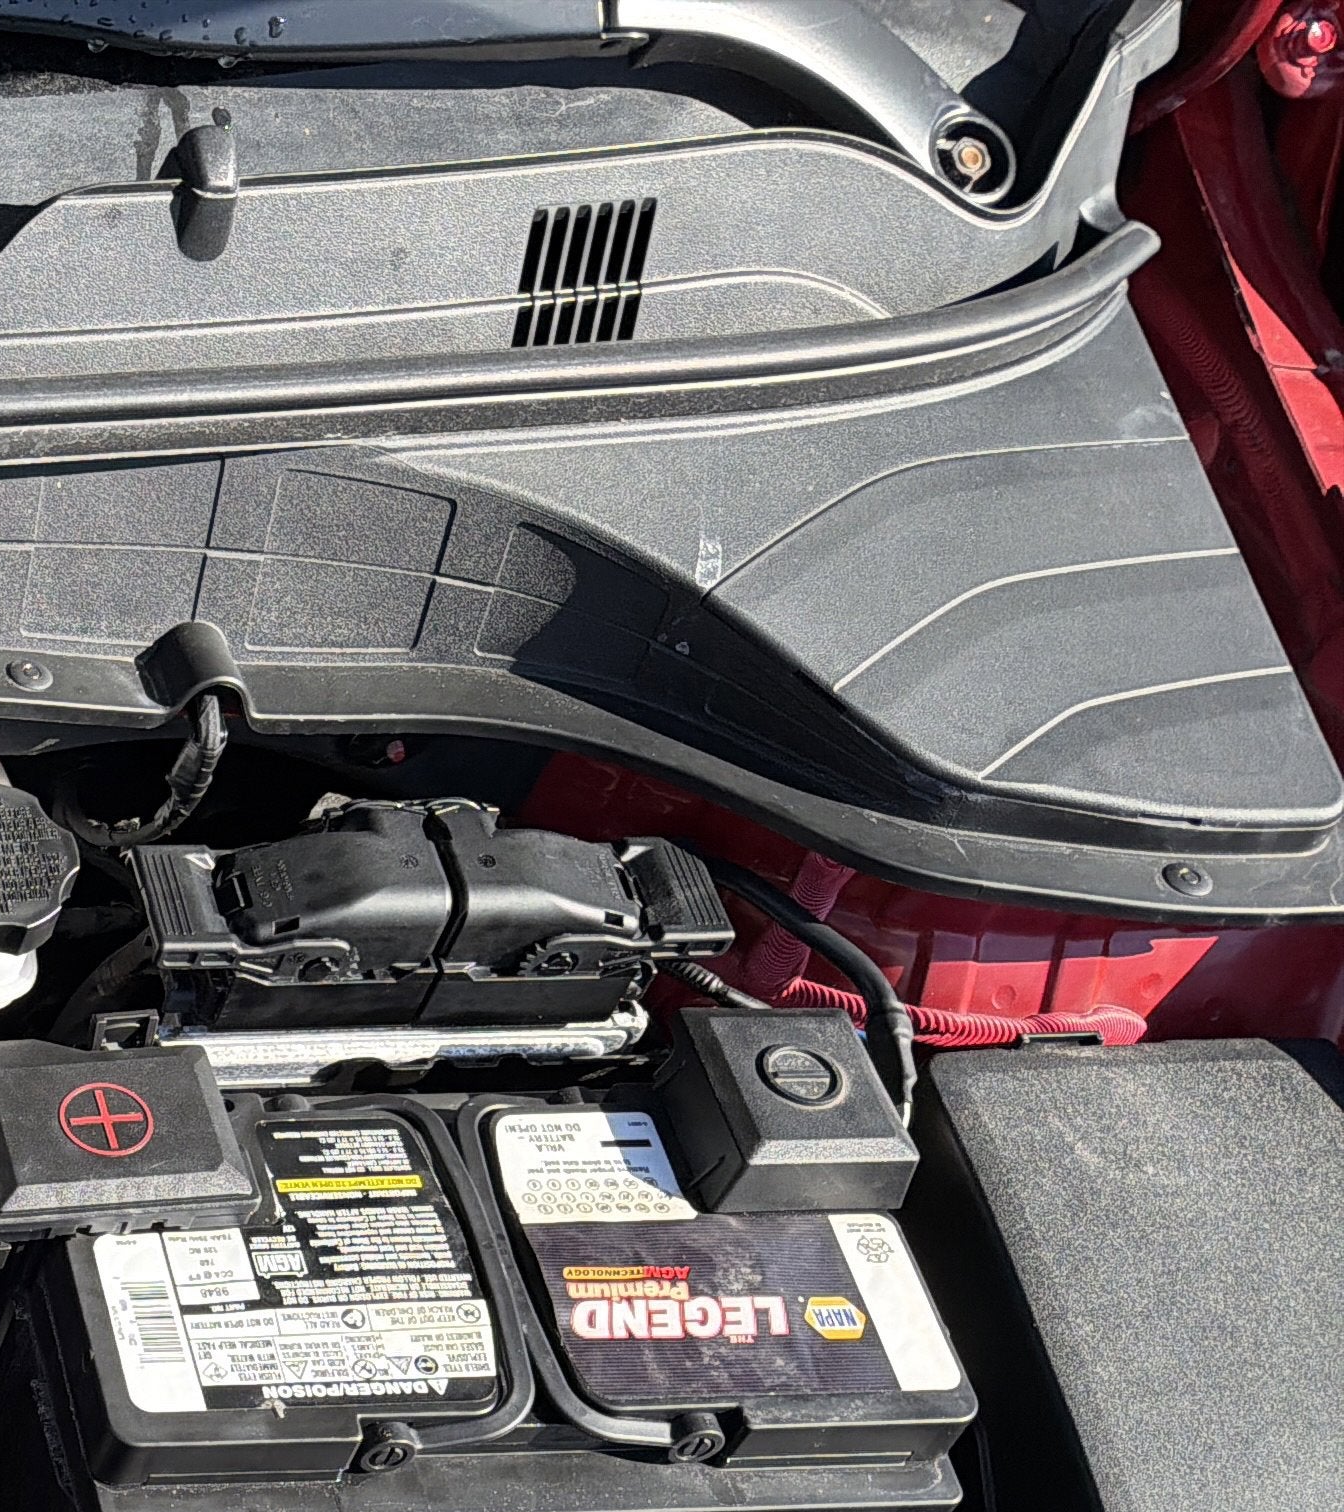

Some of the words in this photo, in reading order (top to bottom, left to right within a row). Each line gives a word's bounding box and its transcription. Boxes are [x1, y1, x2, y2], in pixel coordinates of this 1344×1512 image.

[540, 1124, 562, 1132] NOT
[565, 1124, 580, 1132] DO
[528, 1134, 574, 1142] BATTERY
[257, 1254, 300, 1272] AGM
[214, 1270, 233, 1278] CCA
[566, 1267, 642, 1278] TECHNOLOGY
[642, 1266, 690, 1280] AGM
[200, 1287, 229, 1298] 9848
[567, 1280, 689, 1301] Premium
[263, 1318, 274, 1326] DO
[570, 1296, 789, 1338] LEGEND
[813, 1309, 857, 1327] NAPA
[191, 1321, 222, 1330] BATTERY
[224, 1320, 244, 1328] OPEN
[729, 1335, 754, 1344] THE
[262, 1381, 429, 1399] DANGER/POISON
